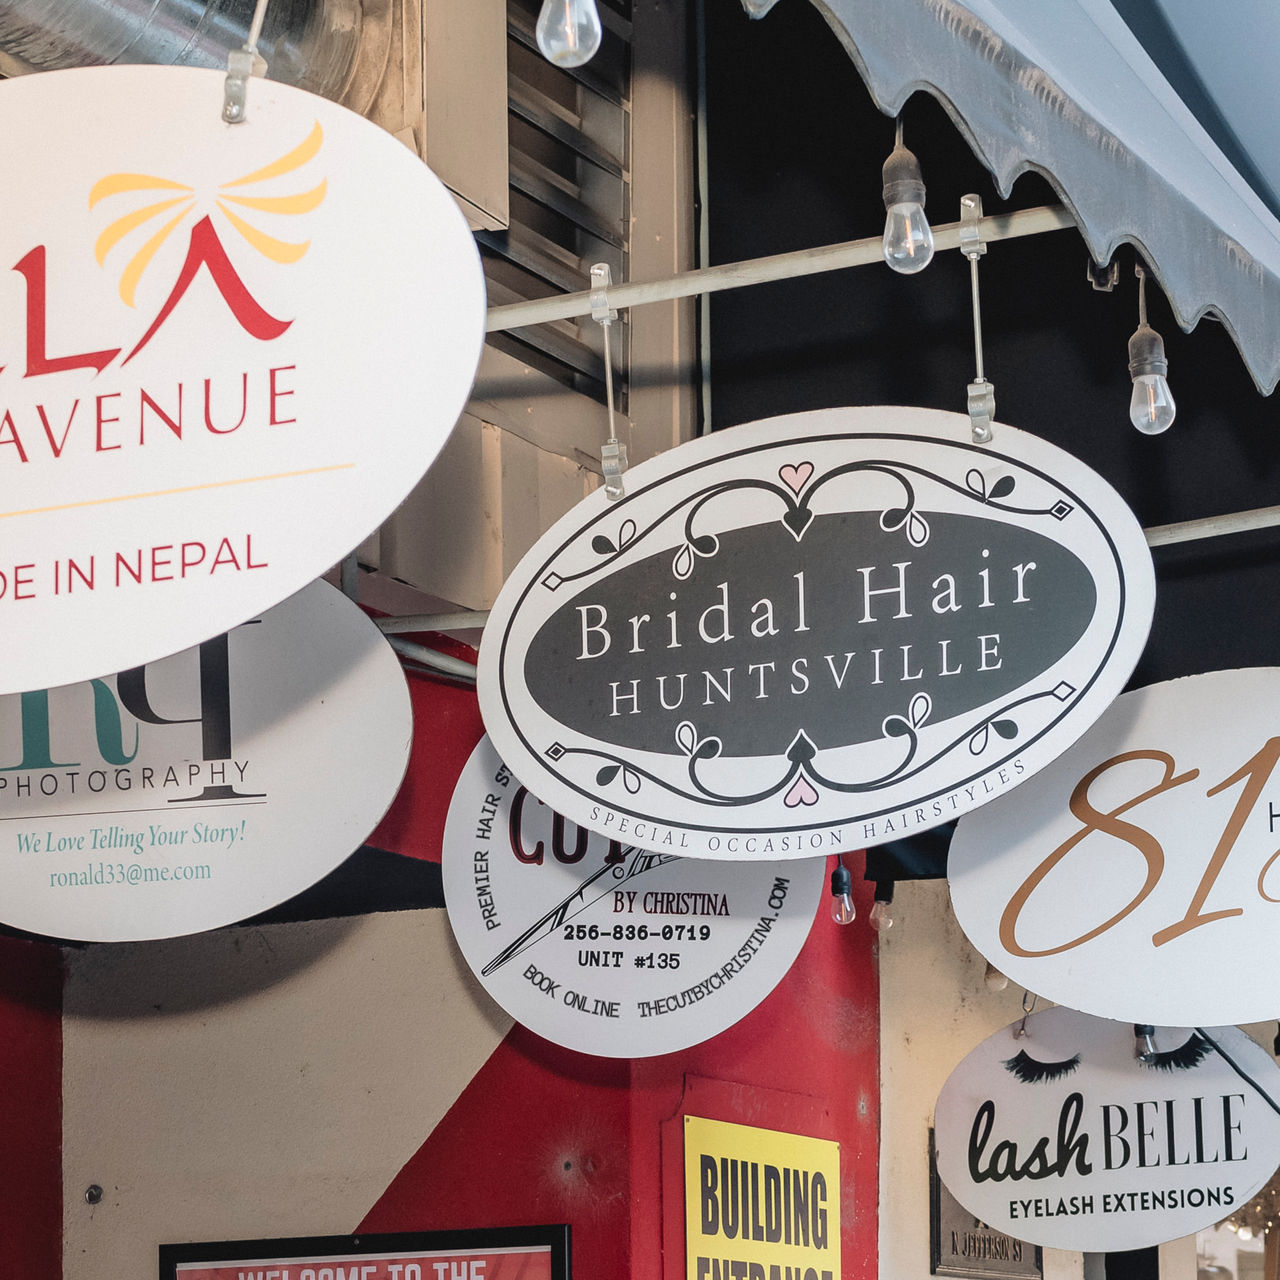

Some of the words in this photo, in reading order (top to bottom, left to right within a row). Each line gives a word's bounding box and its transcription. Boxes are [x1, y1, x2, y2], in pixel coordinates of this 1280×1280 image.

[52, 555, 97, 596] IN
[114, 532, 269, 587] NEPAL
[574, 570, 811, 661] Bridal
[856, 548, 1038, 624] Hair
[608, 632, 1004, 717] HUNTSVILLE
[475, 792, 502, 841] HAIR
[589, 806, 690, 848] SPECIAL
[707, 829, 844, 853] OCCASION
[862, 757, 1028, 840] HAIRSTYLES
[16, 831, 42, 855] We
[46, 829, 85, 853] Love
[90, 824, 145, 857] Telling
[148, 824, 189, 849] Your
[191, 819, 247, 850] Story!
[49, 860, 212, 889] ronald33@me.com
[473, 848, 502, 932] PREMIER
[612, 890, 639, 914] BY
[643, 891, 731, 917] CHRISTINA
[523, 962, 562, 1001] BOOK
[563, 989, 622, 1019] ONLINE
[637, 876, 792, 1019] THECUTBYCHRISTINA.COM
[562, 923, 712, 942] 256-836-0719
[578, 949, 624, 969] UNIT
[633, 951, 682, 971] #135
[967, 1092, 1094, 1184] lash
[1103, 1093, 1249, 1172] BELLE
[700, 1153, 828, 1250] BUILDING
[1009, 1194, 1095, 1220] EYELASH
[1103, 1185, 1236, 1214] EXTENSIONS
[962, 1232, 1010, 1261] JEFFERSON
